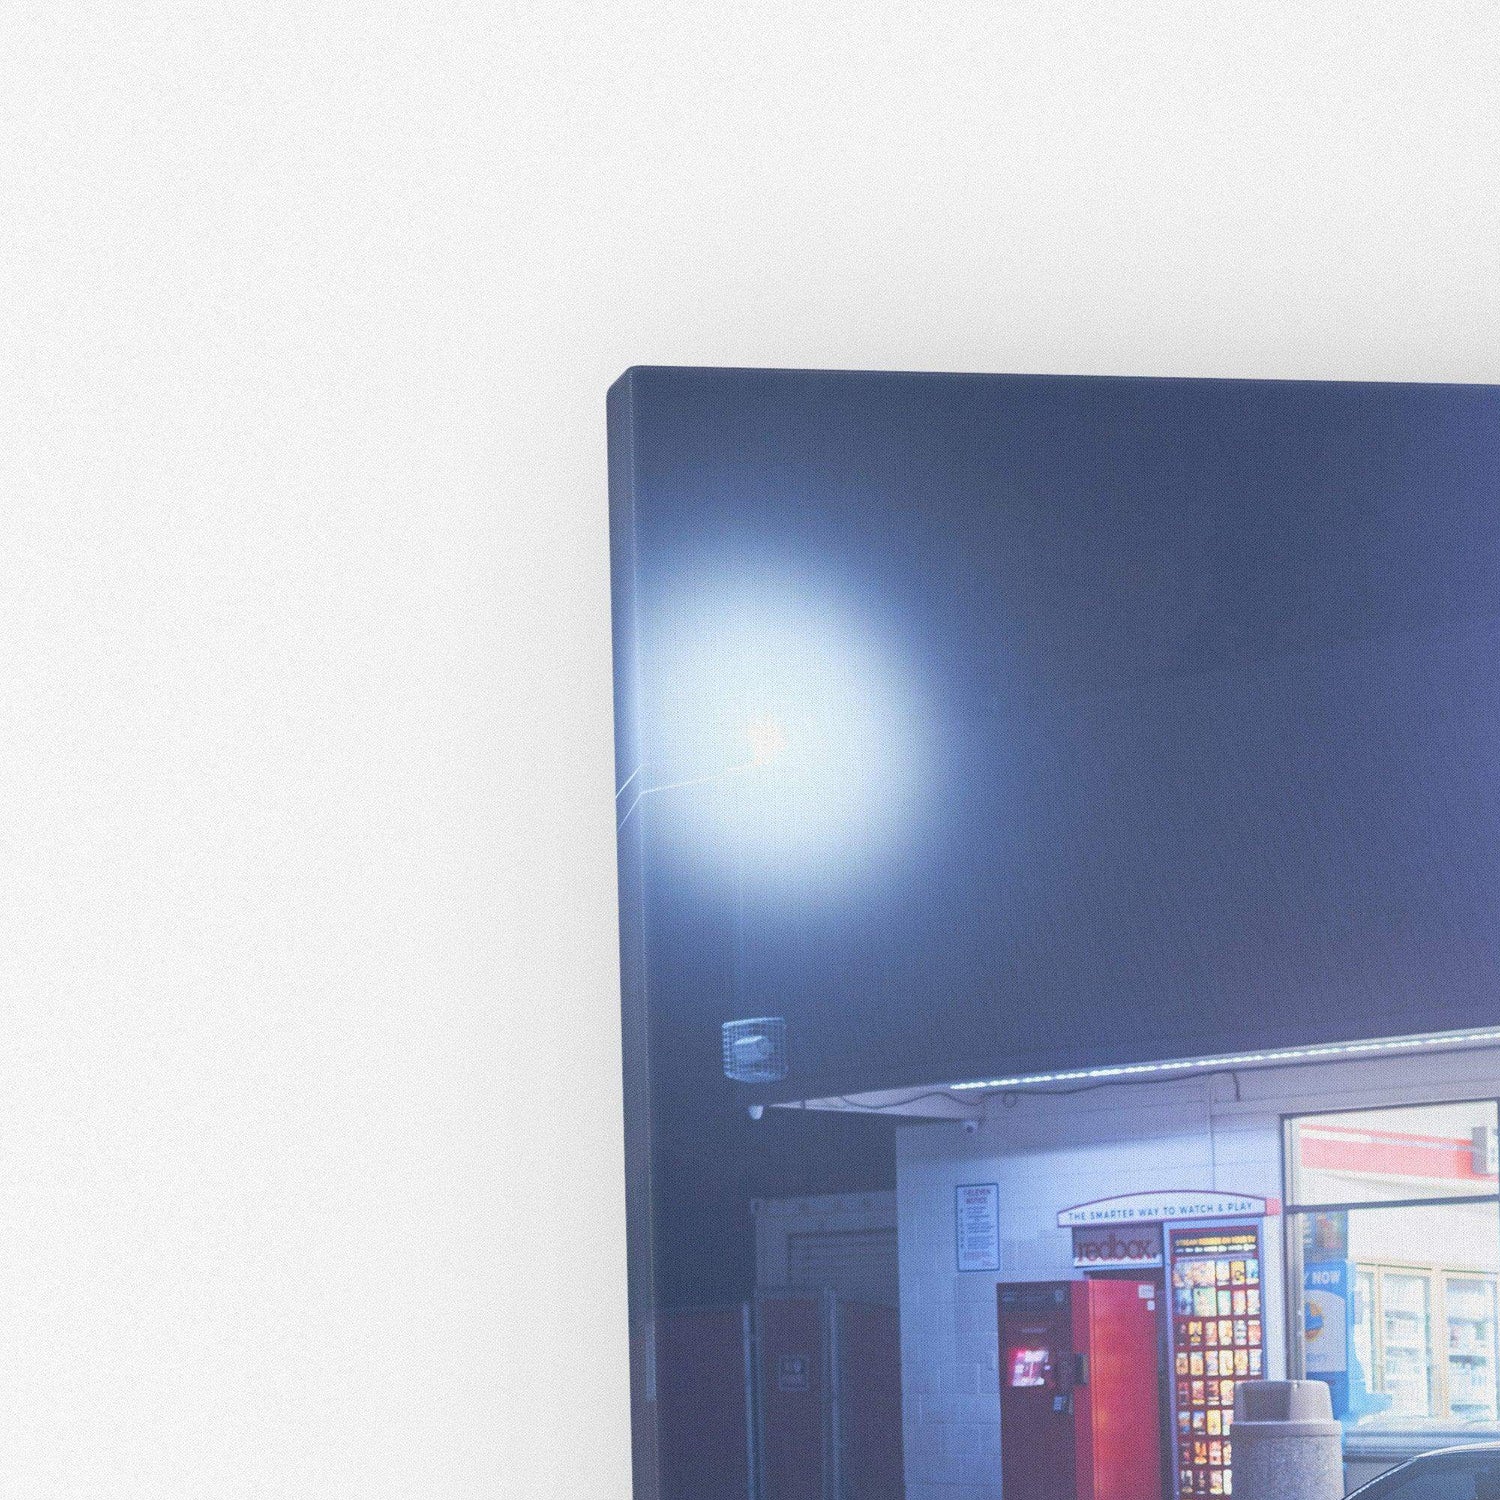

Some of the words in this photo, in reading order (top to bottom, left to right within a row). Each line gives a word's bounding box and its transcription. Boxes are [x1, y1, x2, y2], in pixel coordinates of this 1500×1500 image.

[1069, 1211, 1086, 1222] THE
[1090, 1208, 1134, 1220] SMARTER
[1139, 1207, 1159, 1217] WAY
[1163, 1206, 1175, 1216] TO
[1179, 1204, 1213, 1215] WATCH
[1218, 1203, 1223, 1212] &
[1227, 1202, 1253, 1212] PLAY
[1312, 1270, 1341, 1285] NOW
